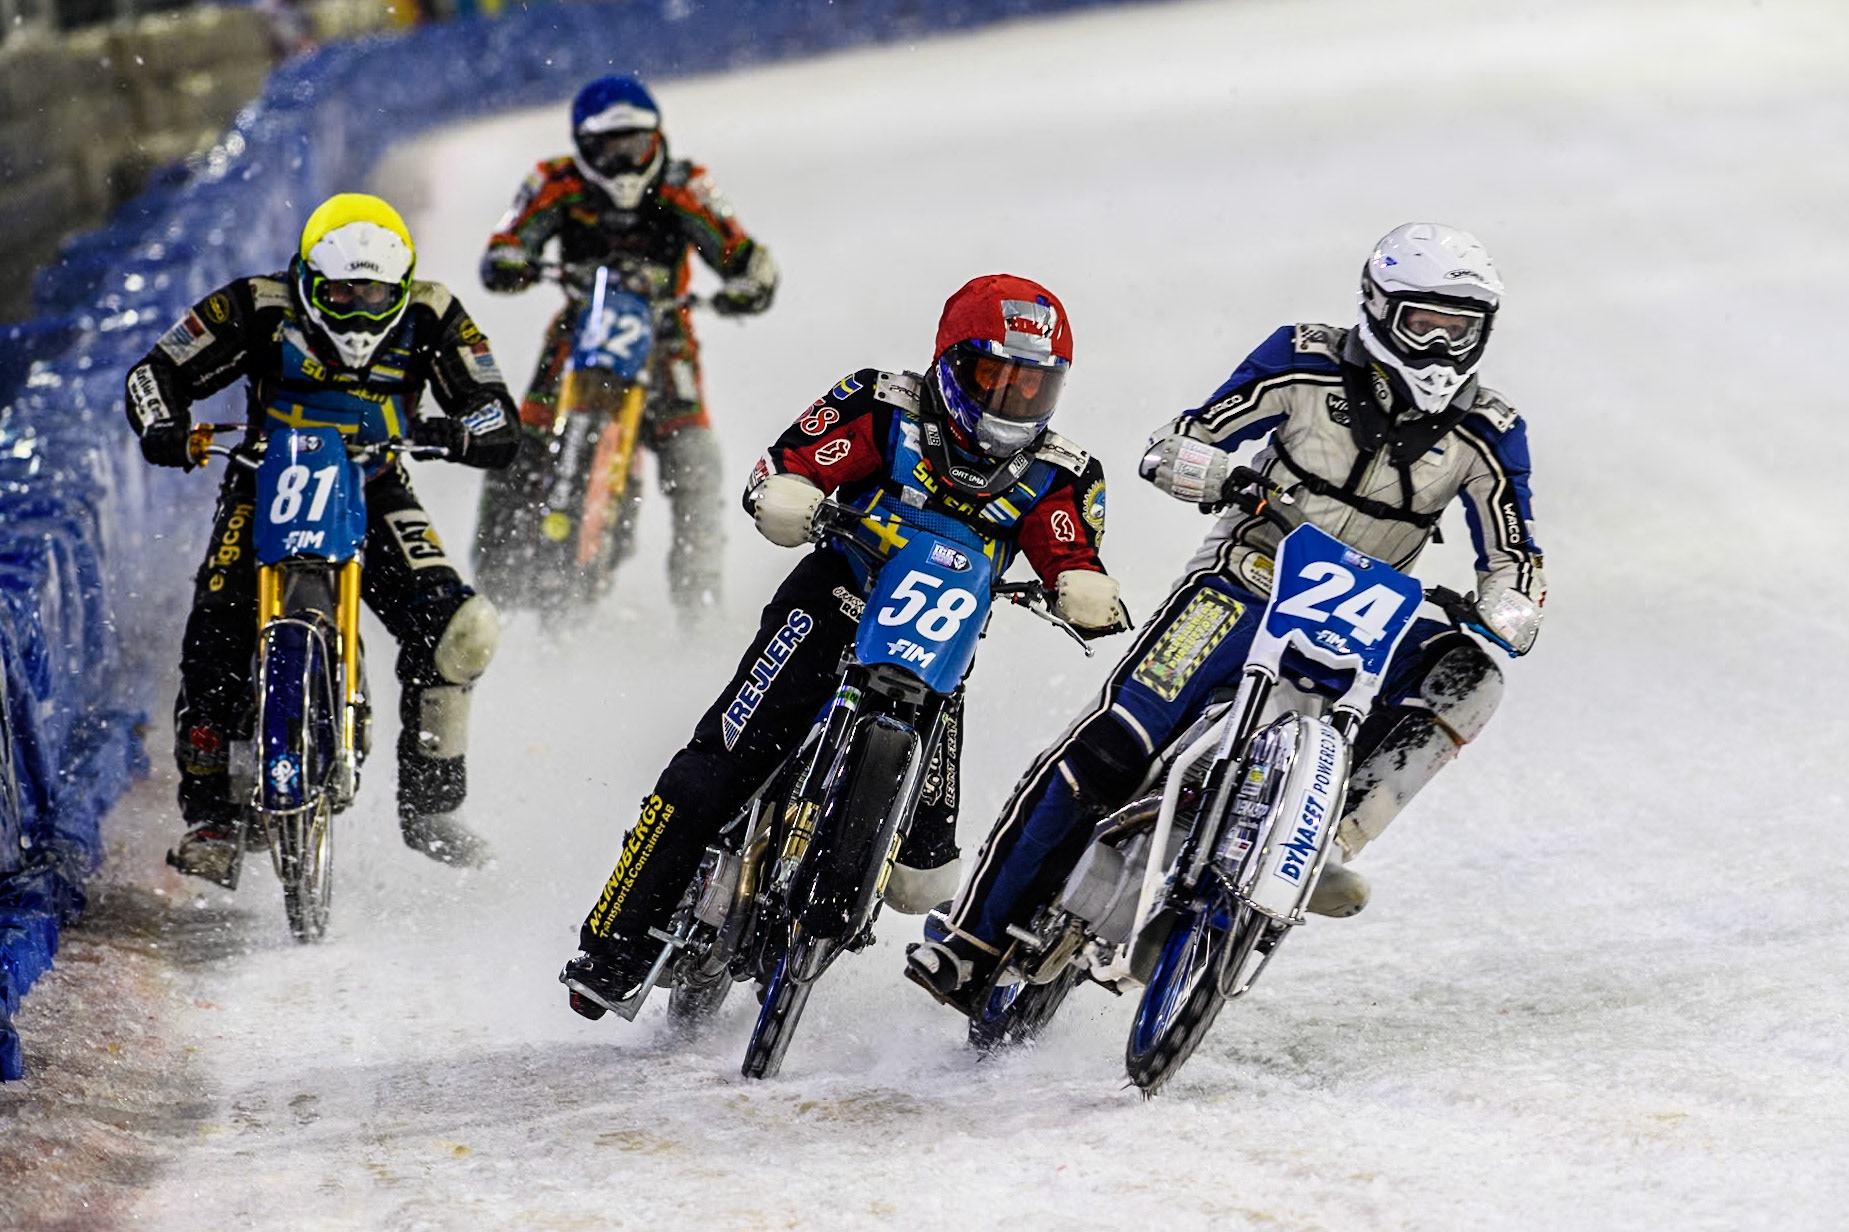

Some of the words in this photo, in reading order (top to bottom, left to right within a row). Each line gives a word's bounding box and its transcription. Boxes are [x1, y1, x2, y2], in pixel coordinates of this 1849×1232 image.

[270, 464, 339, 525] 81
[282, 530, 326, 550] FIM
[392, 520, 445, 560] CAT
[1503, 502, 1521, 544] WACO
[877, 569, 978, 642] 58
[1275, 560, 1407, 647] 24
[886, 638, 937, 670] FIM
[1315, 629, 1348, 648] FIM
[725, 608, 814, 728] REJLERS
[661, 803, 675, 823] AB
[1278, 795, 1325, 881] DYNASET
[1313, 739, 1336, 796] POWERED
